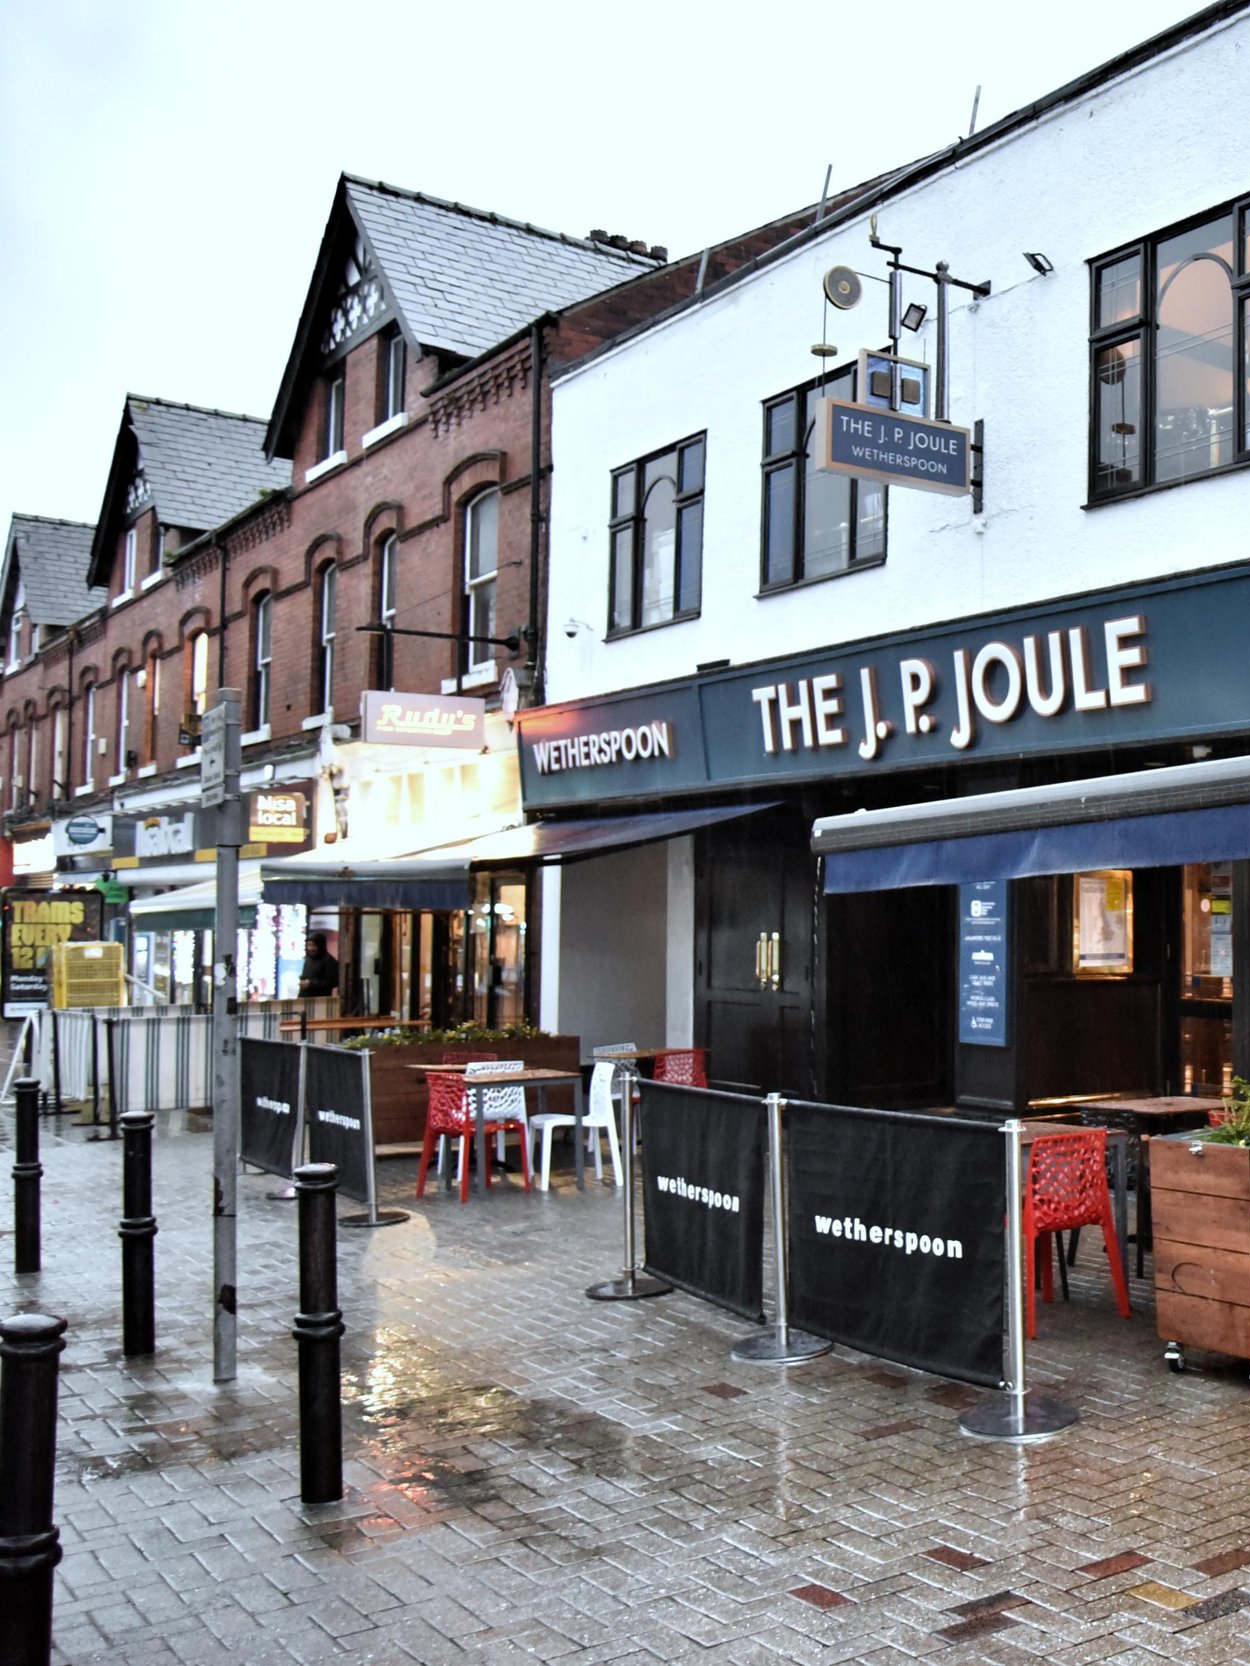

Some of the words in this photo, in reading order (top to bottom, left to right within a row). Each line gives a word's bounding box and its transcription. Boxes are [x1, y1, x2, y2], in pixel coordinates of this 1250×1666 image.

[840, 416, 873, 437] THE
[878, 425, 889, 444] J.
[894, 428, 904, 443] P.
[908, 431, 958, 455] JOULE
[852, 445, 947, 474] WETHERSPOON
[752, 673, 848, 753] THE
[858, 665, 892, 760] J.
[900, 657, 937, 735] P.
[950, 614, 1151, 749] JOULE
[376, 704, 477, 735] Rudy's
[533, 721, 673, 775] WETHERSPOON
[257, 811, 297, 825] local
[12, 901, 84, 924] TRAMS
[11, 924, 72, 946] EVERY
[11, 946, 34, 969] 12
[319, 1110, 361, 1130] wetherspoon
[657, 1175, 740, 1212] wetherspoon
[816, 1215, 963, 1259] wetherspoon
